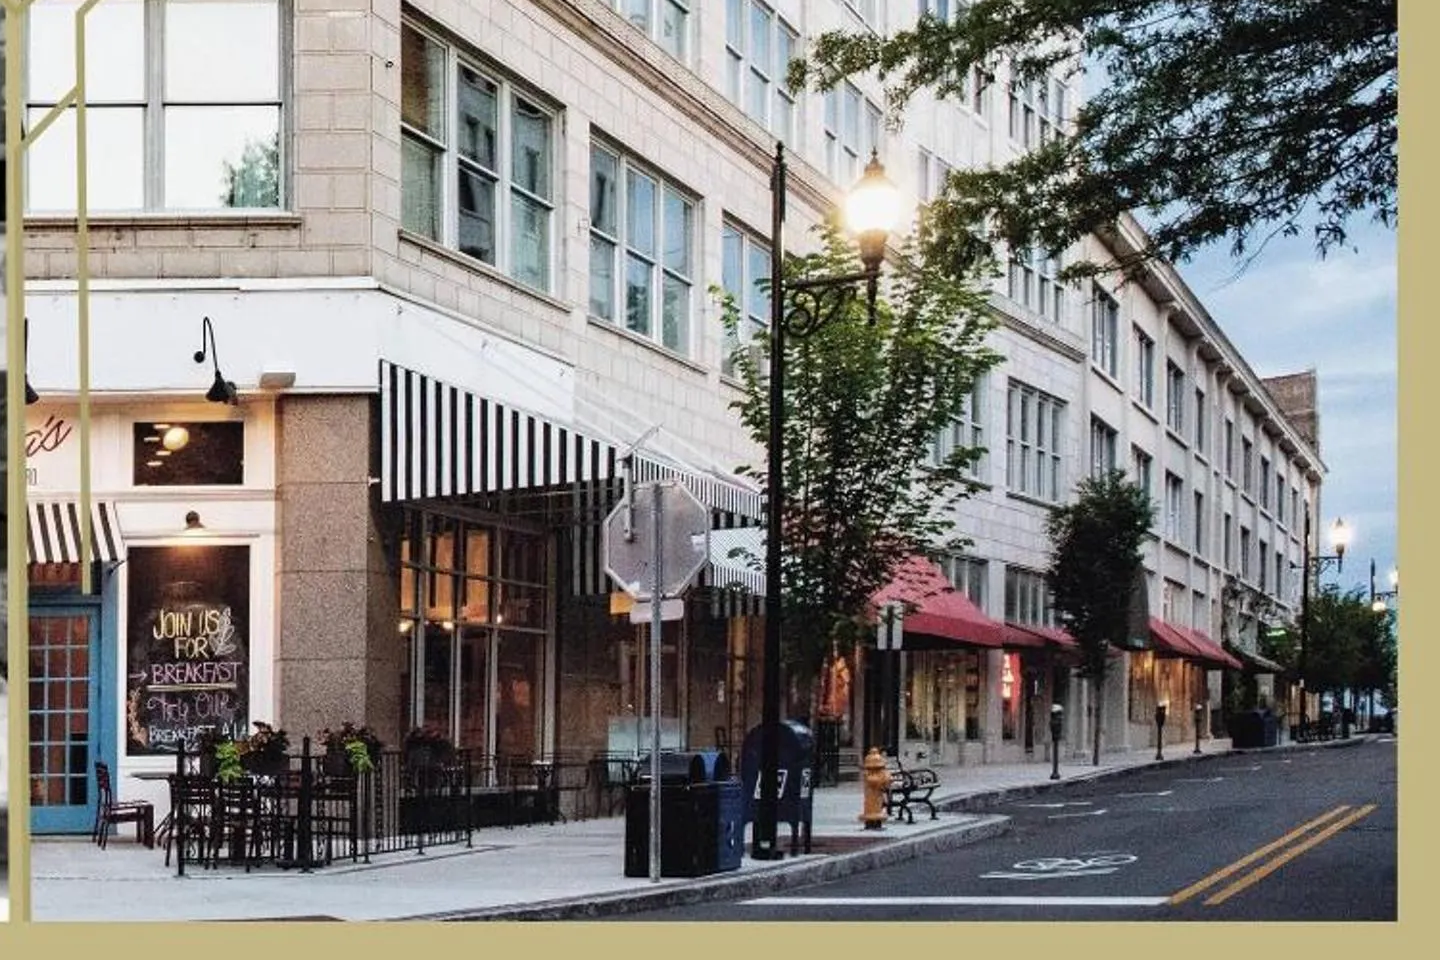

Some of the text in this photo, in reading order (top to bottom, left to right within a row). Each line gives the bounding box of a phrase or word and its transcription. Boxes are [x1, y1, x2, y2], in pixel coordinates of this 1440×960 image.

[153, 608, 220, 640] JOIN US
[174, 637, 209, 660] FOR
[151, 662, 242, 685] BREAKFAST
